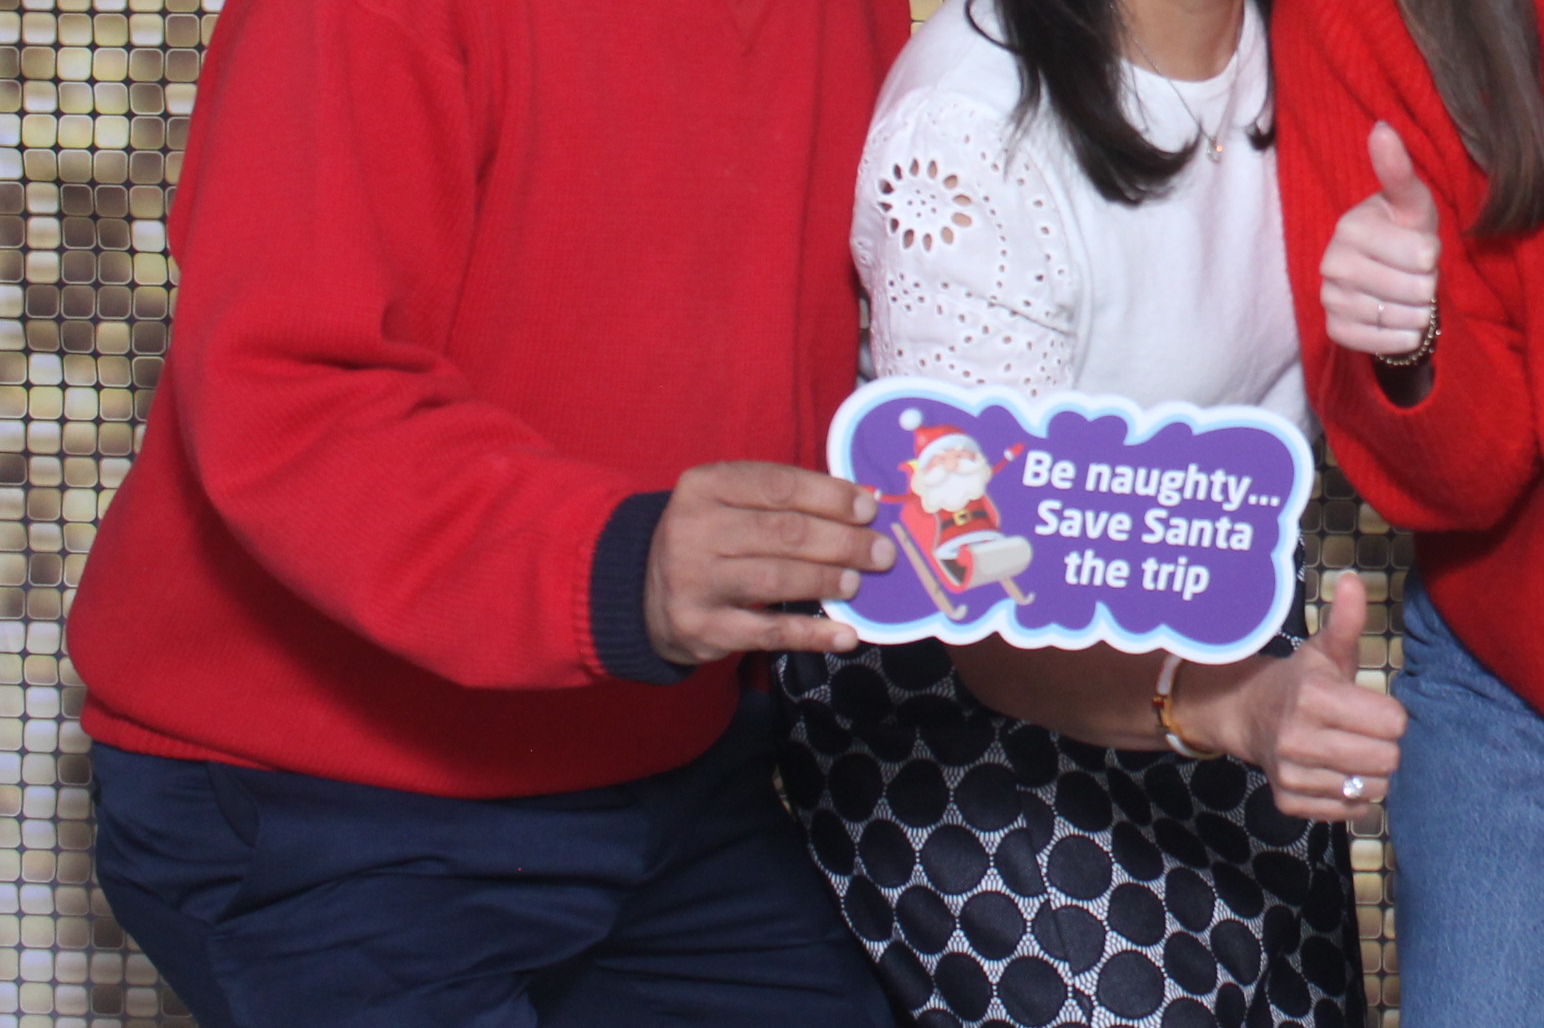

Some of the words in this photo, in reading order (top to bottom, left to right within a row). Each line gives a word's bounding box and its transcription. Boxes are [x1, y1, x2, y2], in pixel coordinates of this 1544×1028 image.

[1021, 449, 1076, 490] Be
[1084, 462, 1281, 511] naughty...
[1034, 498, 1132, 541] Save
[1140, 507, 1254, 551] Santa
[1063, 549, 1131, 588] the
[1140, 556, 1210, 601] trip
